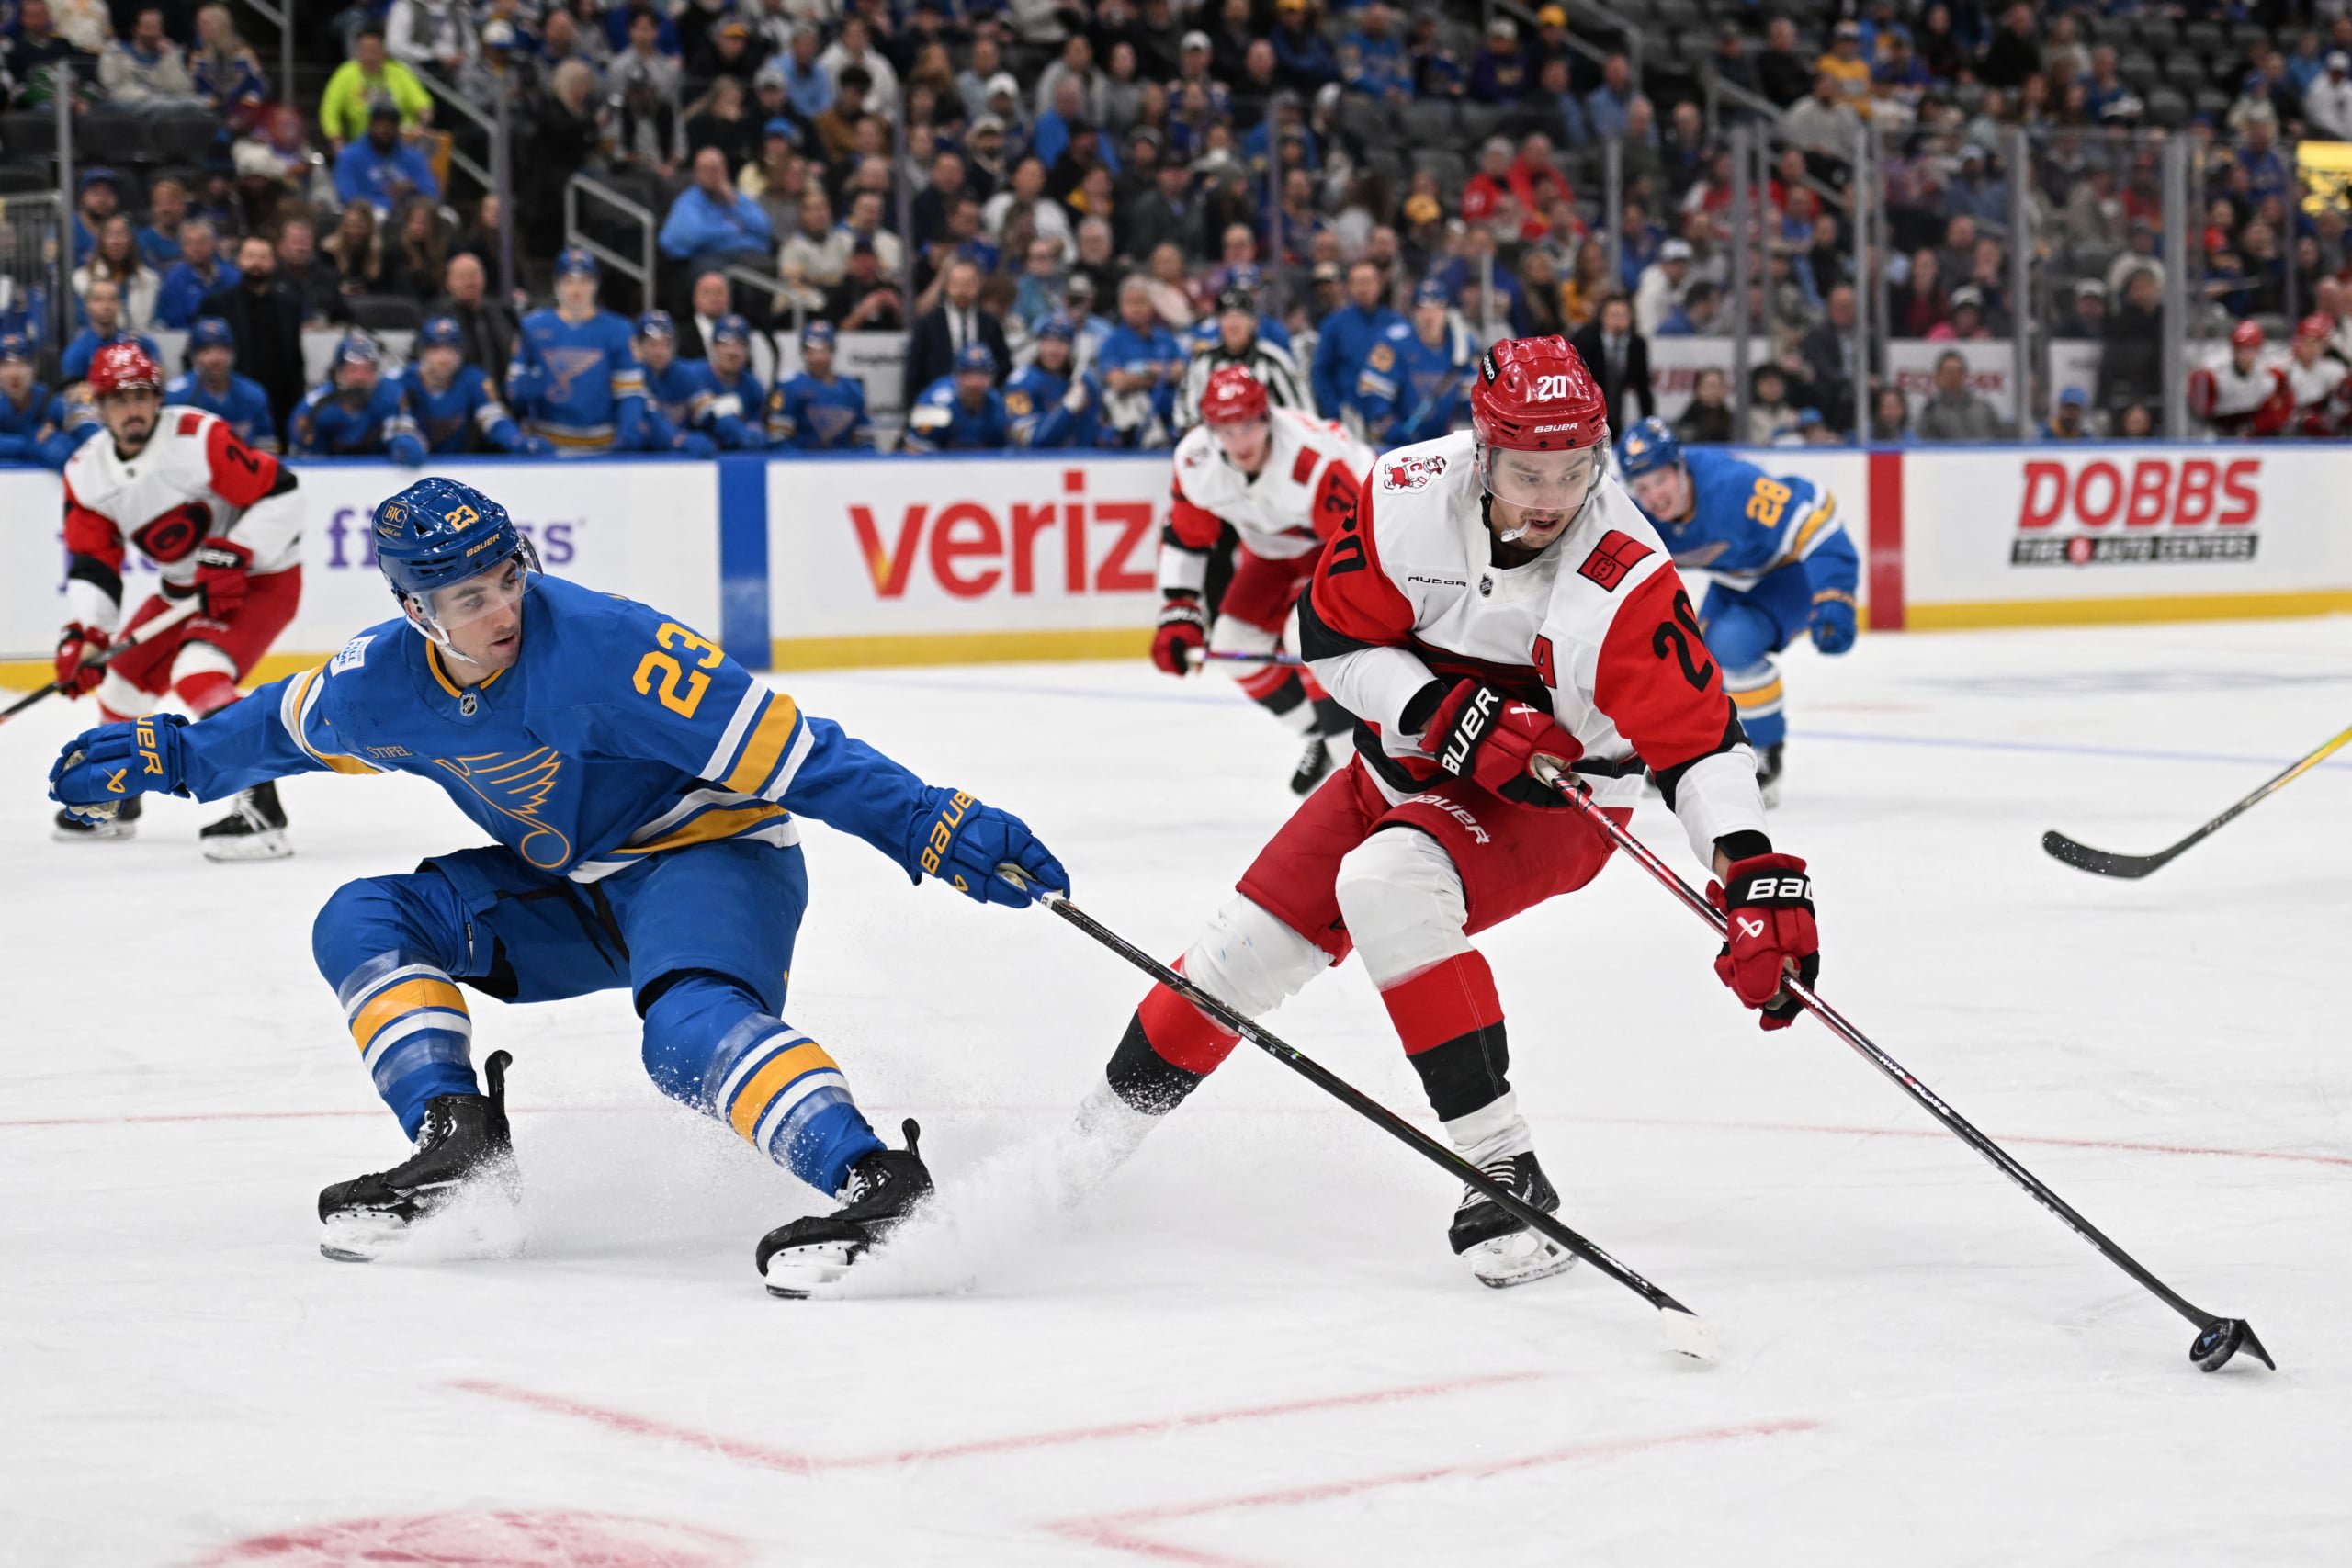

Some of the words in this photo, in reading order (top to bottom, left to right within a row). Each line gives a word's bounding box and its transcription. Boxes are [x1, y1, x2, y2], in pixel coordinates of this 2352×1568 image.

[1537, 375, 1566, 400] 20
[385, 505, 405, 523] BJC
[444, 504, 480, 532] 23
[1747, 477, 1792, 528] 28
[2018, 460, 2261, 528] DOBBS
[847, 468, 1159, 601] veriz
[632, 622, 725, 719] 23
[1532, 633, 1557, 689] A
[367, 745, 413, 759] STIFEL
[920, 790, 977, 875] BAUE
[1415, 794, 1491, 844] AUER
